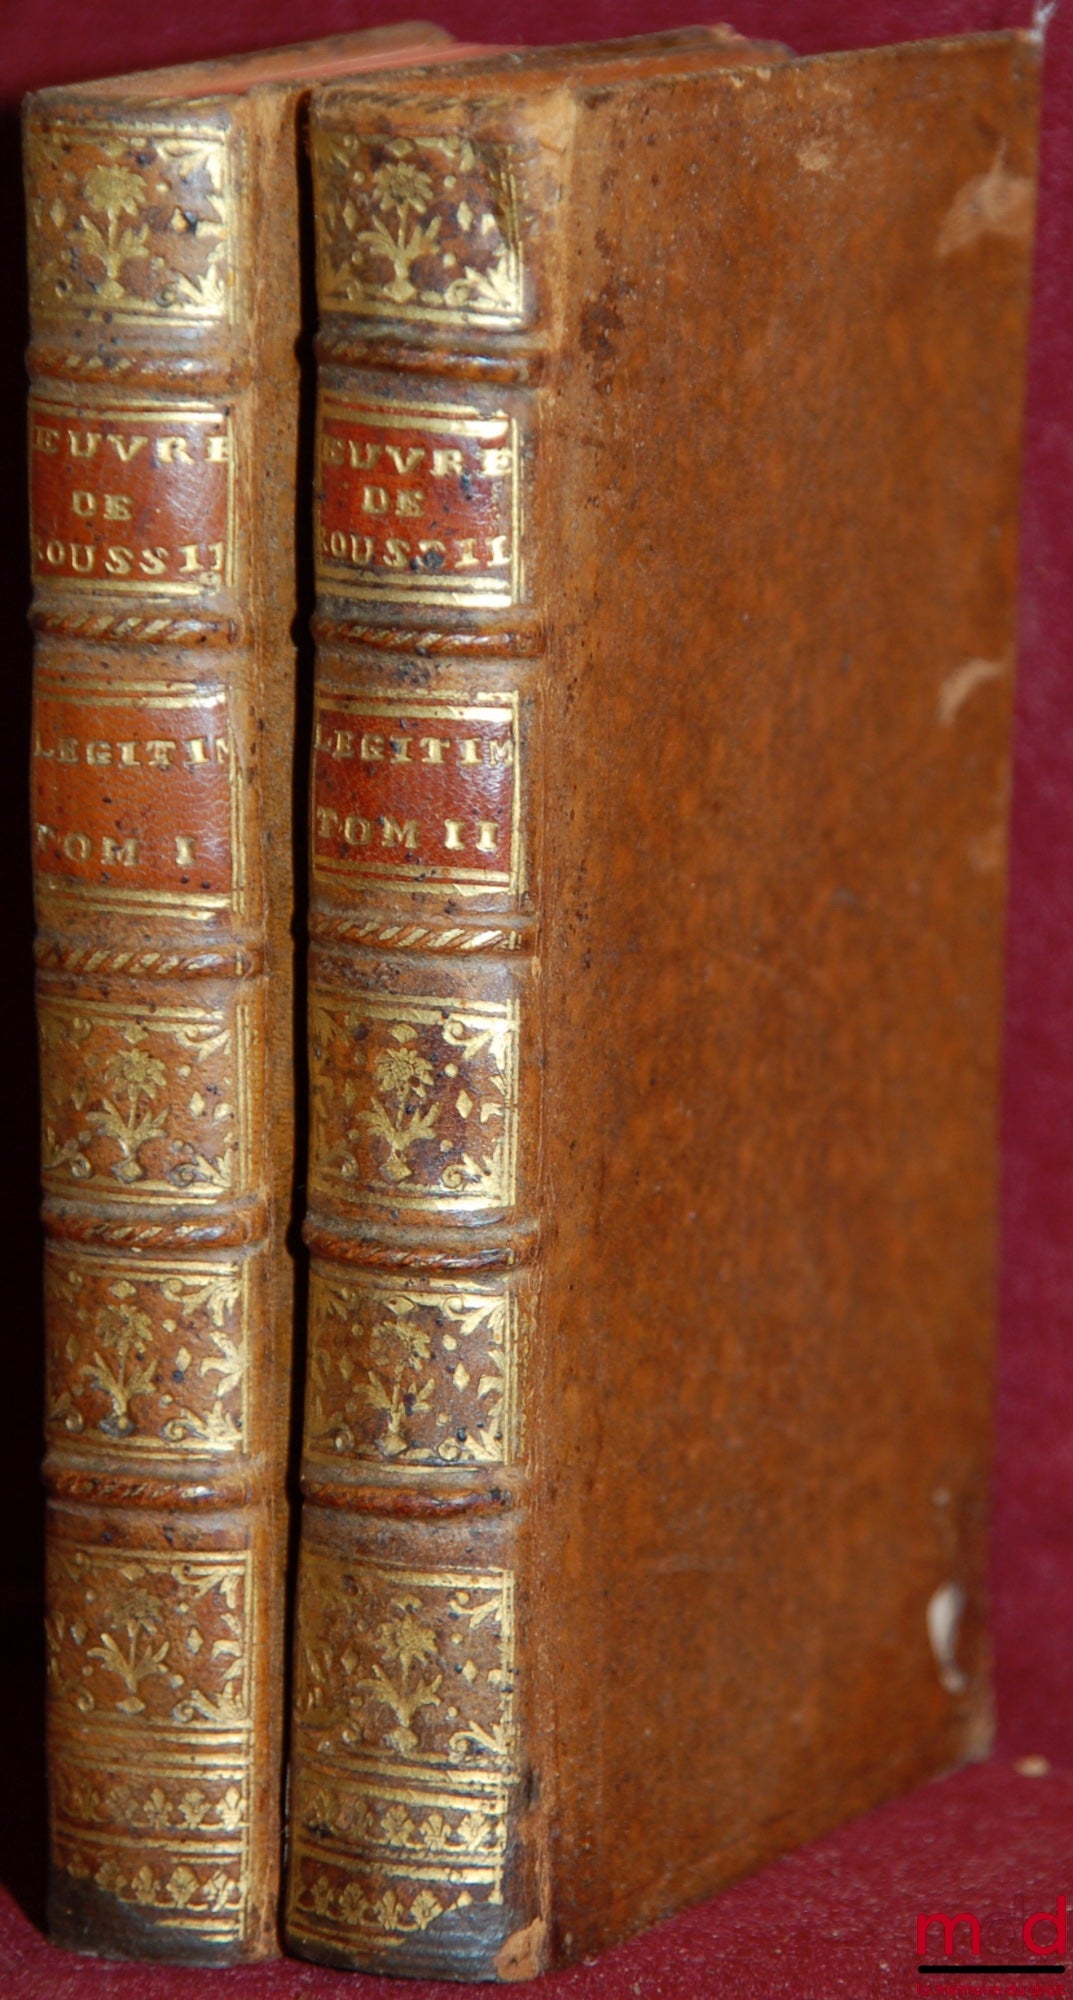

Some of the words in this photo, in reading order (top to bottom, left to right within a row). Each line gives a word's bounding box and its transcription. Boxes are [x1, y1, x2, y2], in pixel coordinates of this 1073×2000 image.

[72, 490, 133, 520] DE
[362, 485, 425, 517] DE
[314, 723, 513, 766] LEGITIM
[316, 805, 420, 849] TOM
[444, 818, 498, 851] II
[175, 835, 197, 867] I
